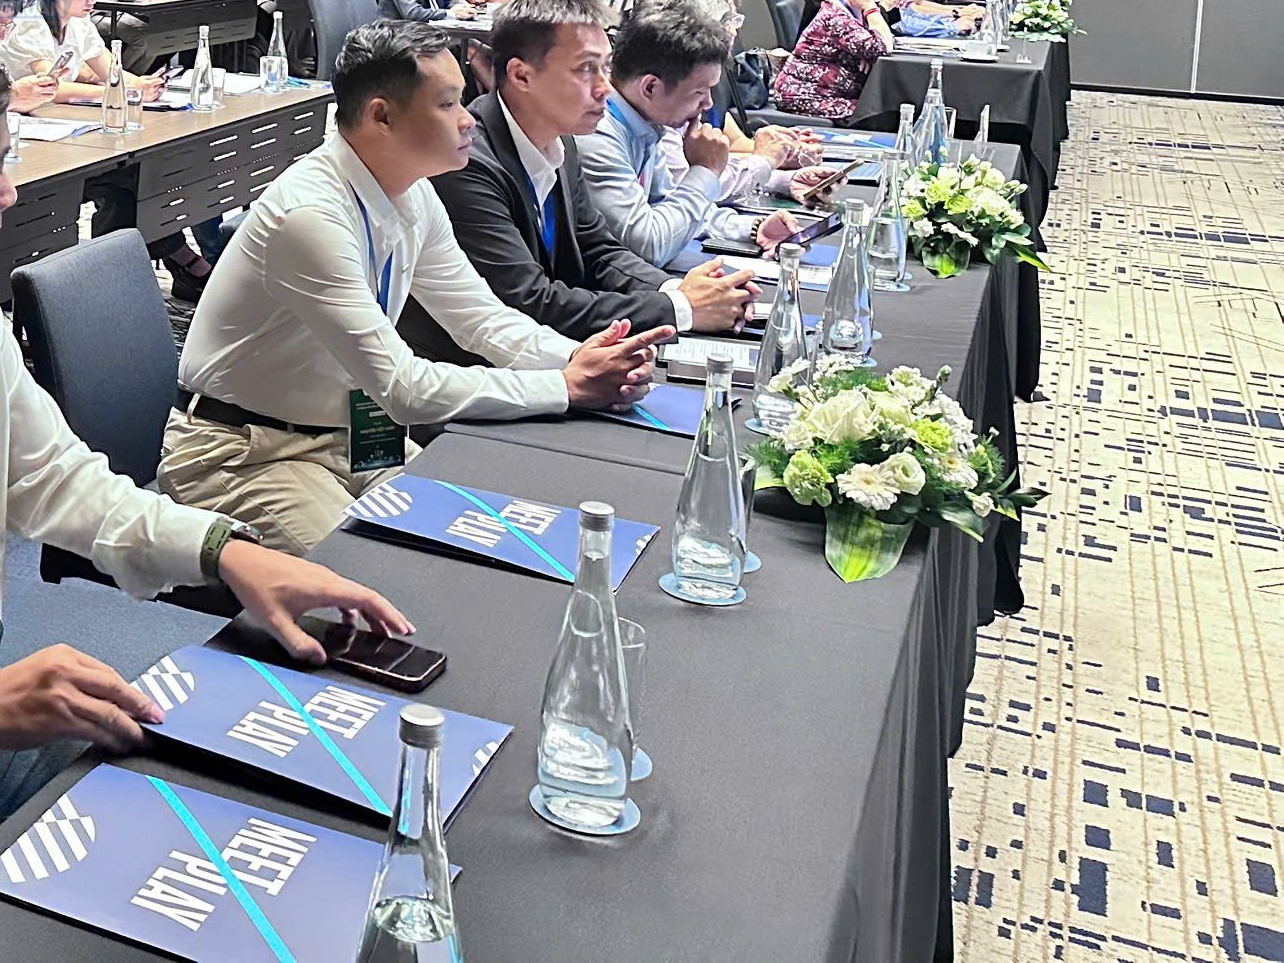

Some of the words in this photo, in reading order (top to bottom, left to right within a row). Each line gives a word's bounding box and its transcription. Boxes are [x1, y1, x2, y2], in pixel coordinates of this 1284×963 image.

[500, 500, 562, 536] MEET
[226, 701, 311, 758] PLAY
[303, 685, 387, 740] MEET
[221, 817, 318, 897] MEET
[130, 850, 229, 933] PLAY
